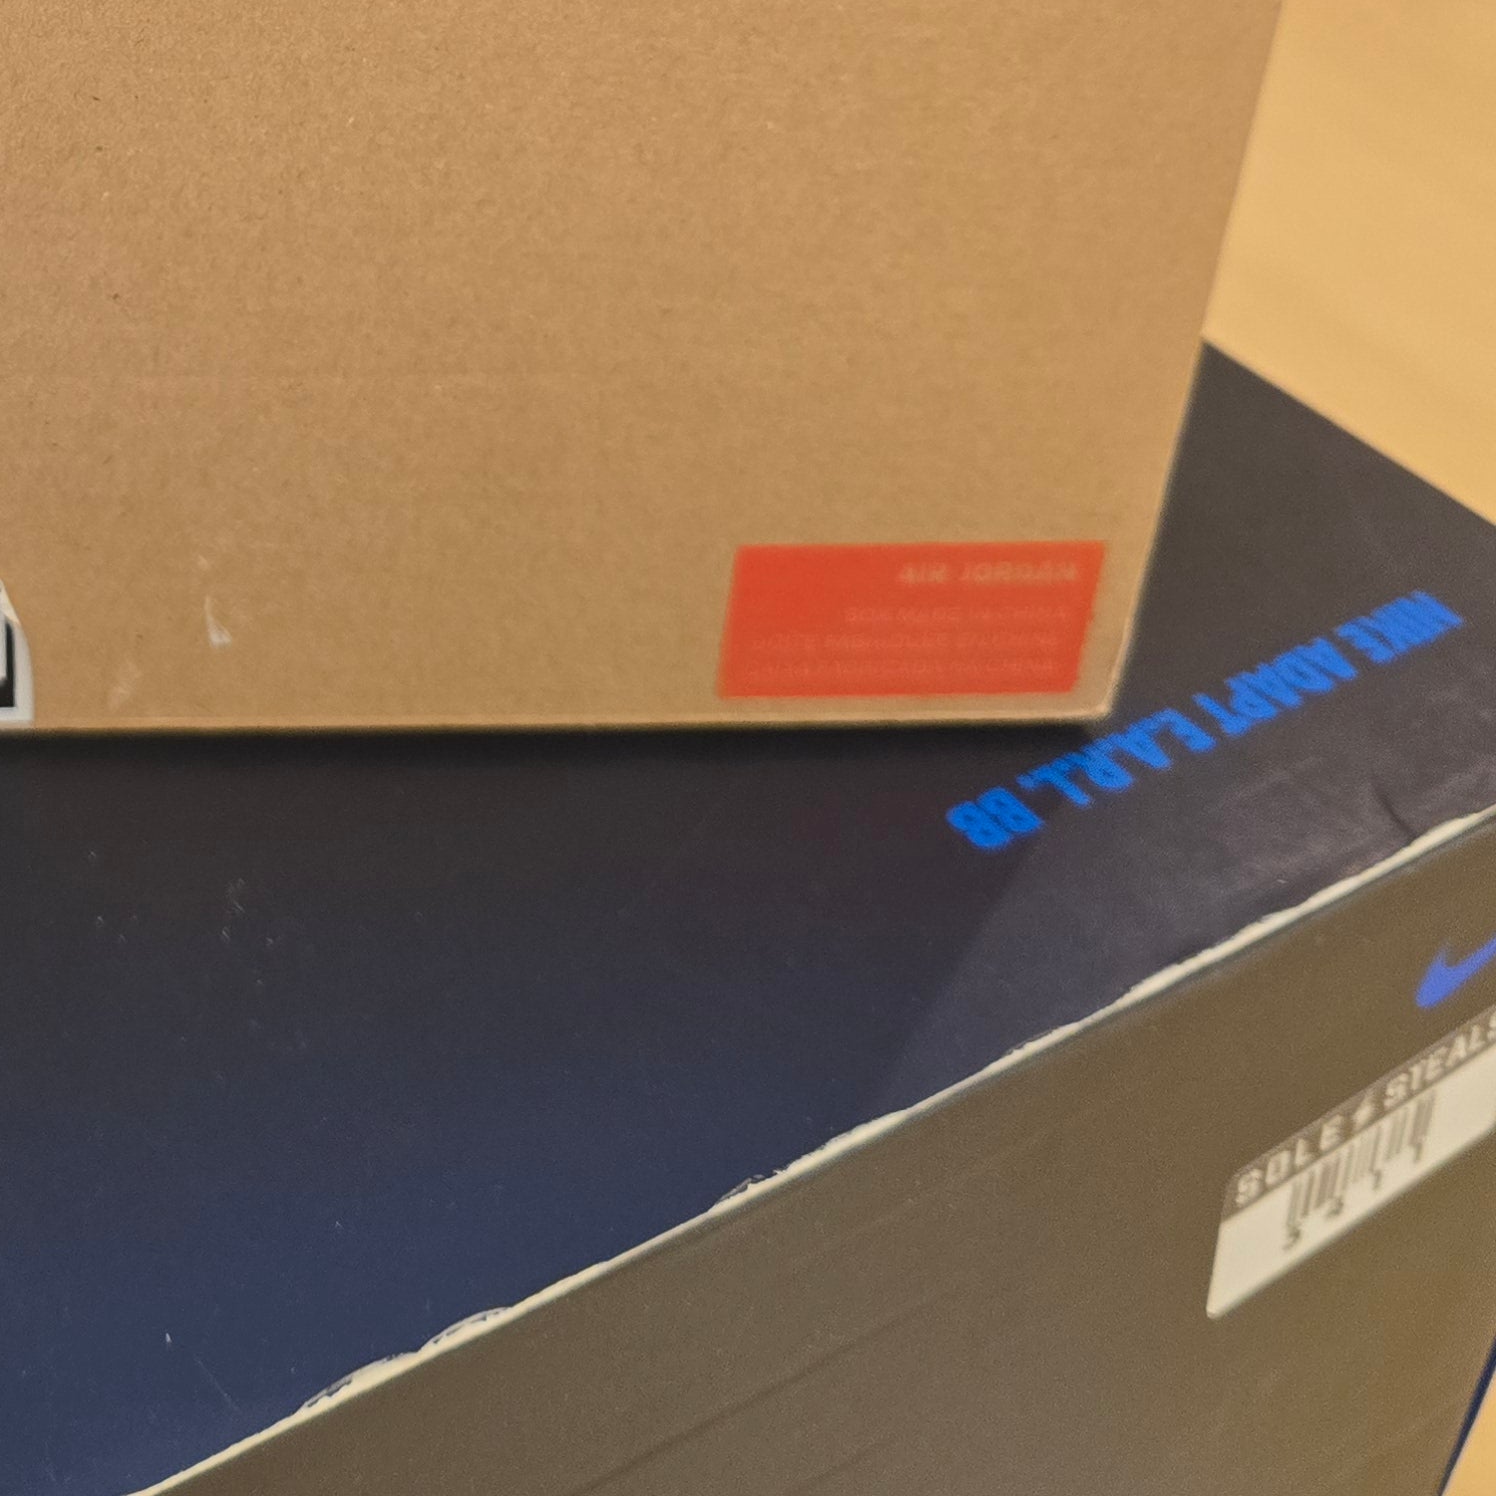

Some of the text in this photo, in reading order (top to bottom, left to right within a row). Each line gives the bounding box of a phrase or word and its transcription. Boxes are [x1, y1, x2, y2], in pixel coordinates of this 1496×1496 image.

[1335, 590, 1465, 665] NIKE
[1194, 637, 1358, 737] ADAPT
[945, 786, 1045, 850] BB
[1235, 1112, 1346, 1206] SOLE
